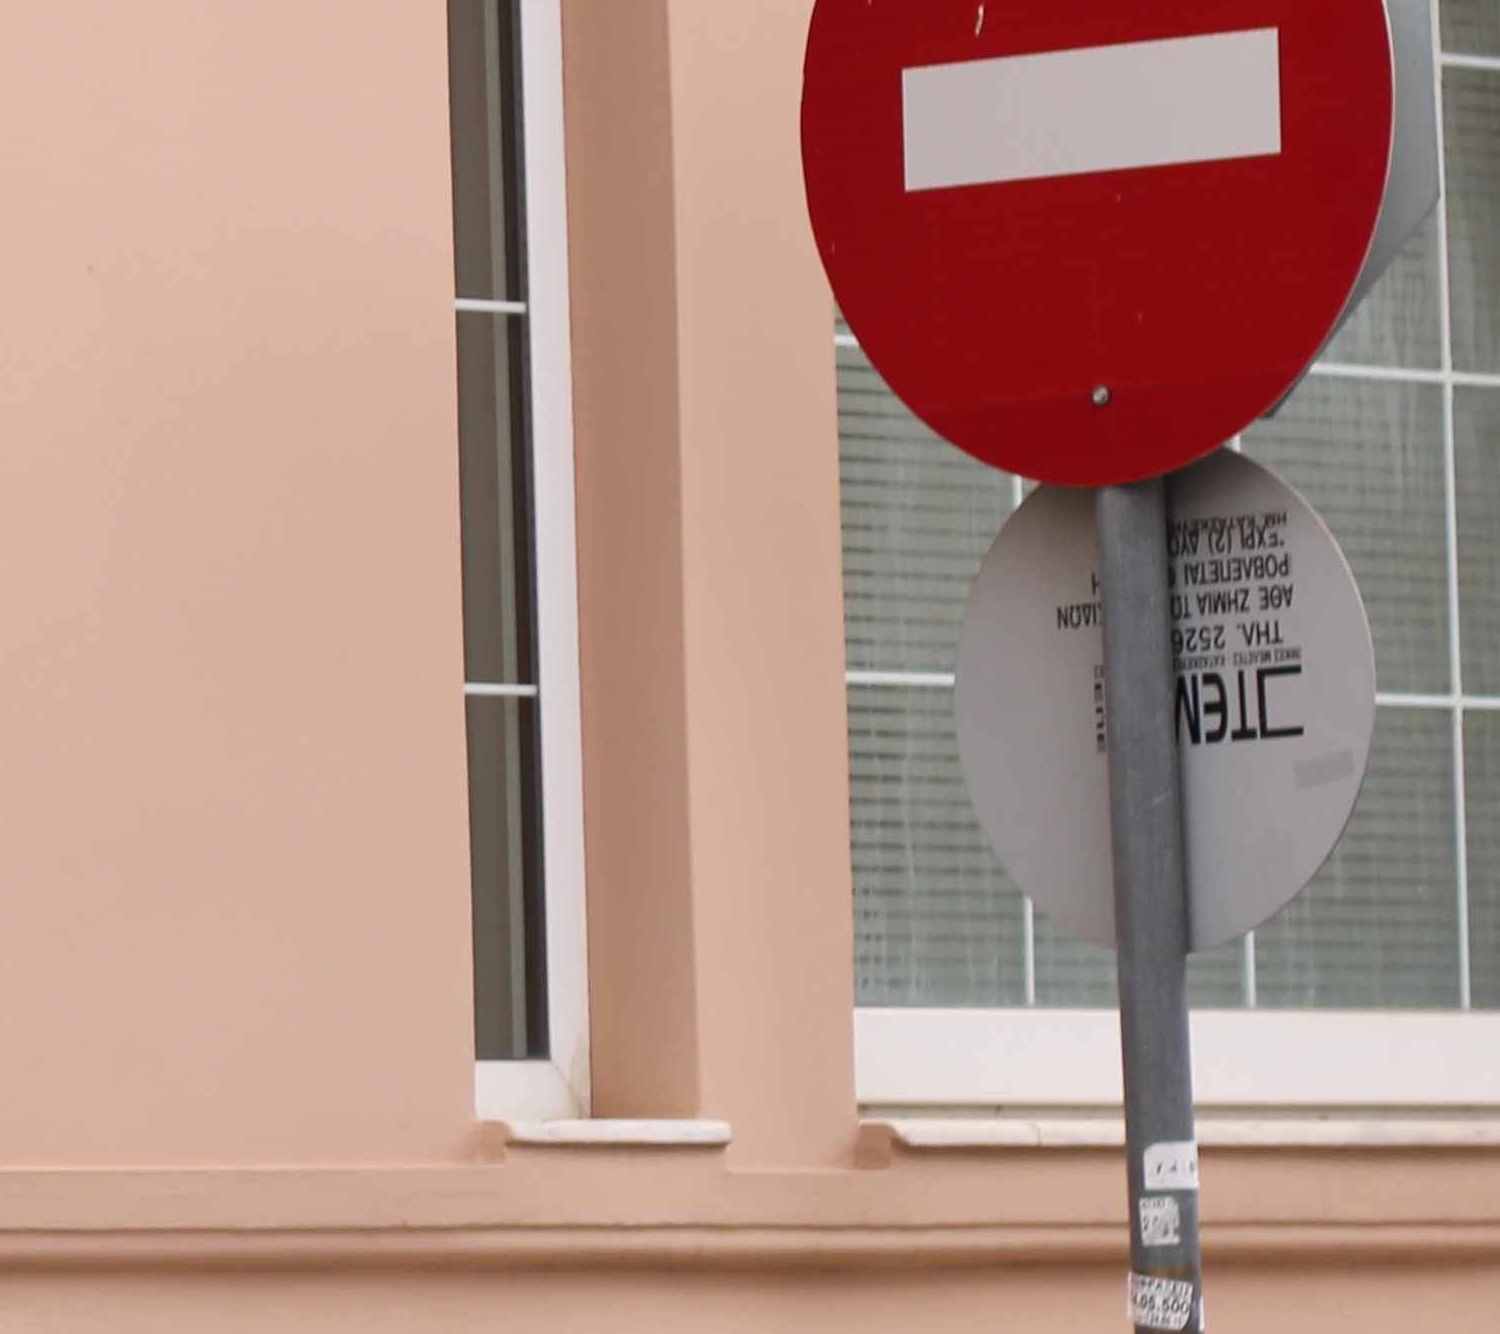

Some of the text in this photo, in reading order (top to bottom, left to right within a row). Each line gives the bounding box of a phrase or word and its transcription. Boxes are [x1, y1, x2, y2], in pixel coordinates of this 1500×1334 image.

[1169, 594, 1192, 620] ΤΩ
[1196, 589, 1251, 617] ΖΗΜΙΑ
[1171, 626, 1226, 655] 2526
